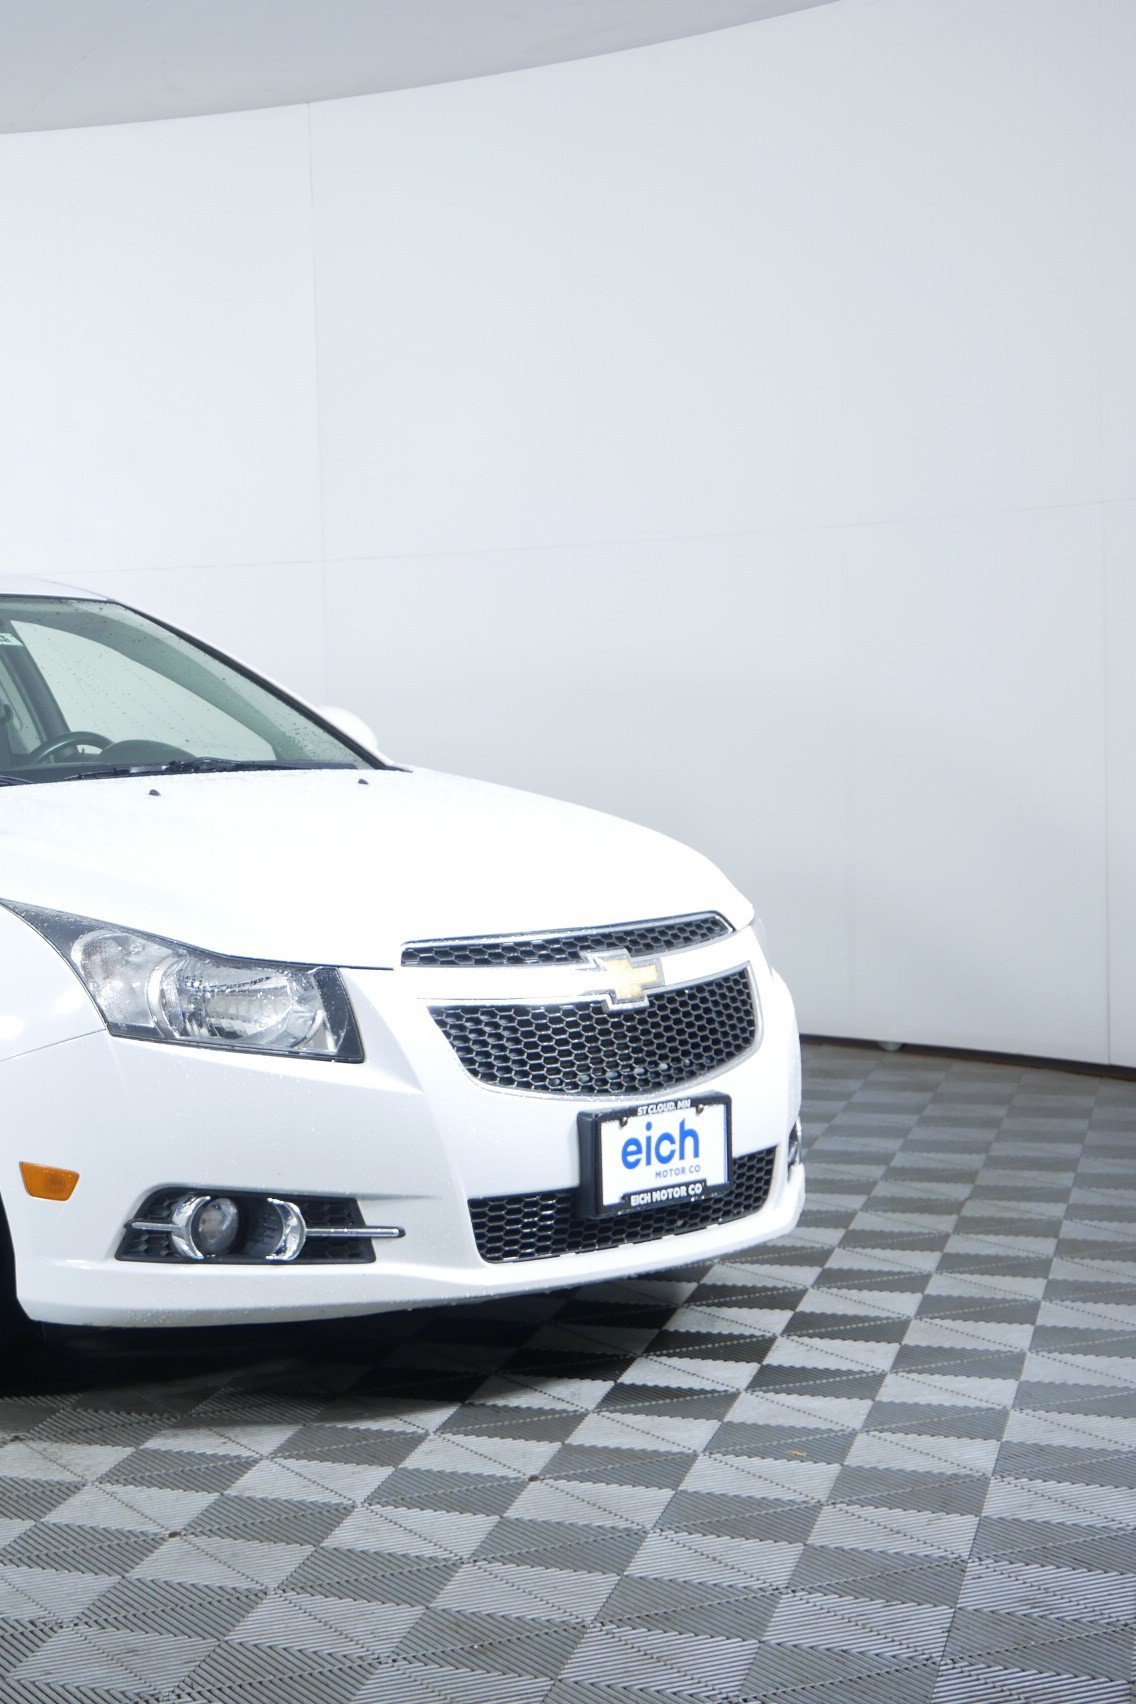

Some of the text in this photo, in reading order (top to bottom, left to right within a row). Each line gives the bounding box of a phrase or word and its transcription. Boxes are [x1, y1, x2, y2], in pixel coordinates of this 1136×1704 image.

[677, 1099, 691, 1110] MN
[621, 1118, 701, 1170] eich
[655, 1164, 701, 1179] MOTOR CO
[630, 1192, 651, 1207] EICH
[652, 1185, 687, 1203] MOTOR
